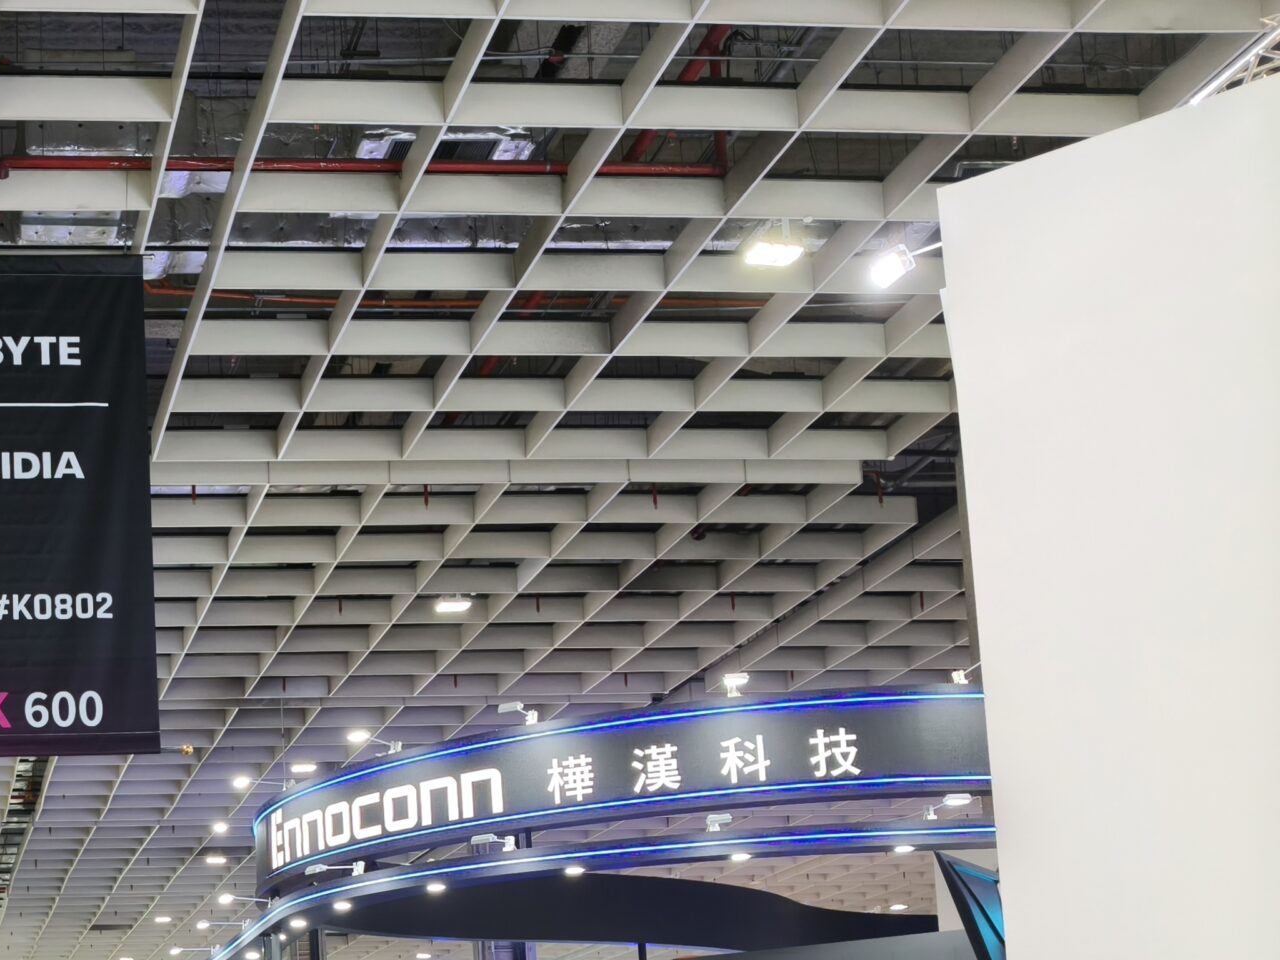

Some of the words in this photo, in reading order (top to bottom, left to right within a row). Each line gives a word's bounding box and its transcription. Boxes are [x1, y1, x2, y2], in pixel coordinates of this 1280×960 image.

[24, 690, 104, 729] 600
[547, 727, 861, 805] 樺漢科技
[270, 768, 504, 870] Ennoconn
